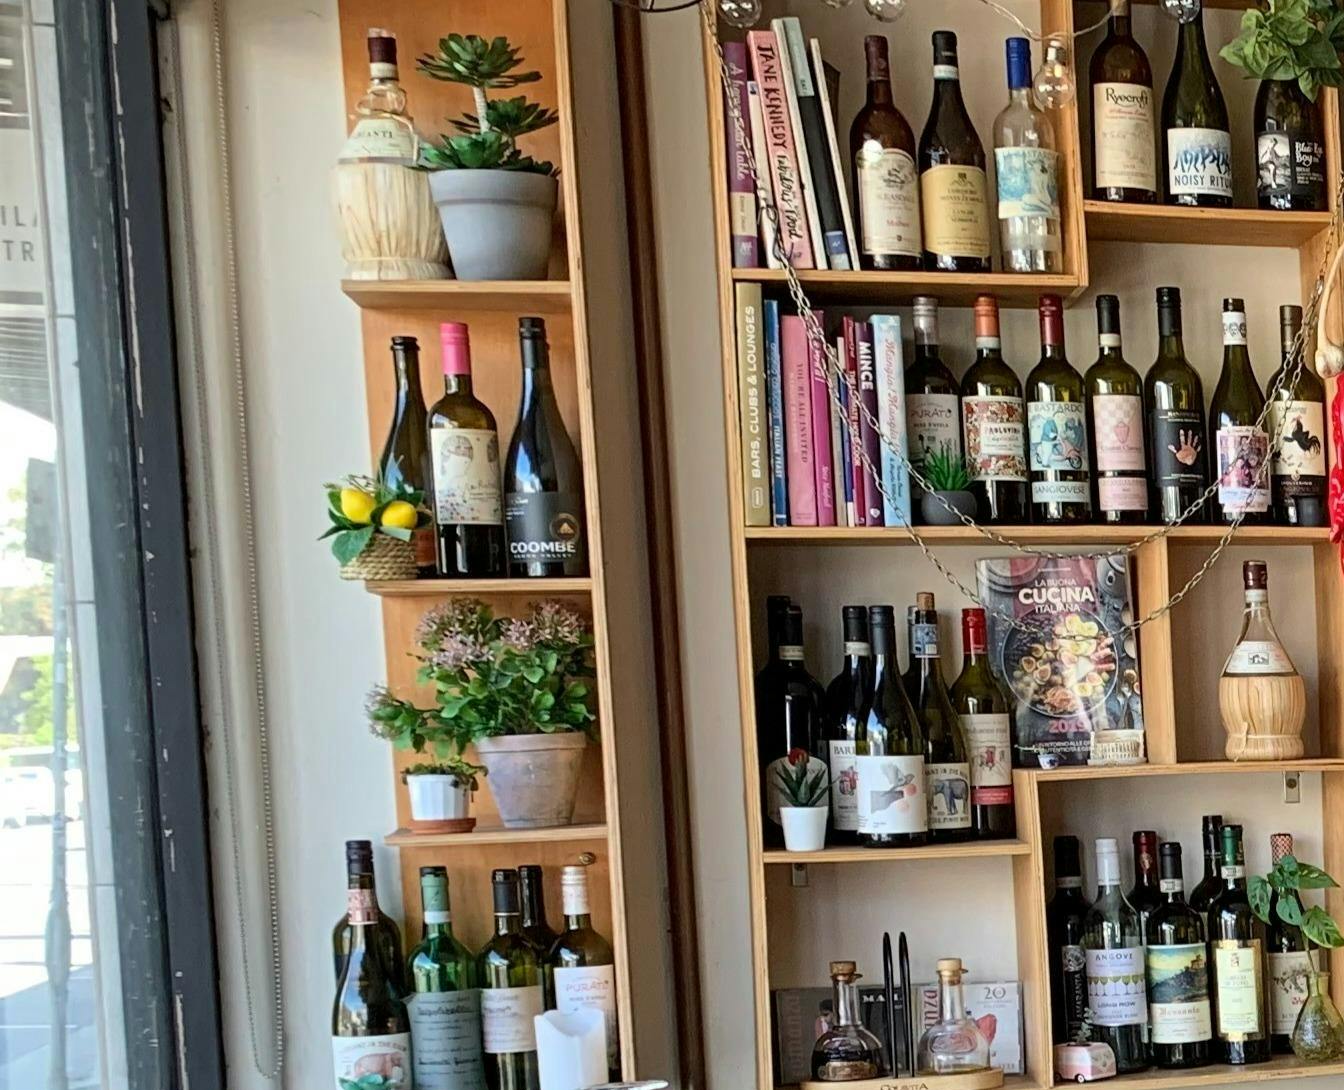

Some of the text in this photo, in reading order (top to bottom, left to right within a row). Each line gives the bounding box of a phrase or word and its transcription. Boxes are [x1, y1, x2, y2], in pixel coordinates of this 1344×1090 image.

[730, 62, 744, 76] A
[758, 44, 776, 83] JANE
[764, 87, 787, 149] KENNEDY
[736, 150, 748, 181] table
[1174, 175, 1205, 186] NOISY
[784, 206, 803, 241] Food
[858, 341, 874, 390] MINCE
[745, 306, 762, 479] BARS, CLUBS & LOUNGES
[773, 425, 781, 456] ITALIAN
[800, 421, 808, 463] INVITED
[774, 456, 783, 478] FEAST
[511, 541, 576, 554] COOMBE
[1018, 587, 1094, 605] CUCINA
[984, 986, 1006, 999] 20
